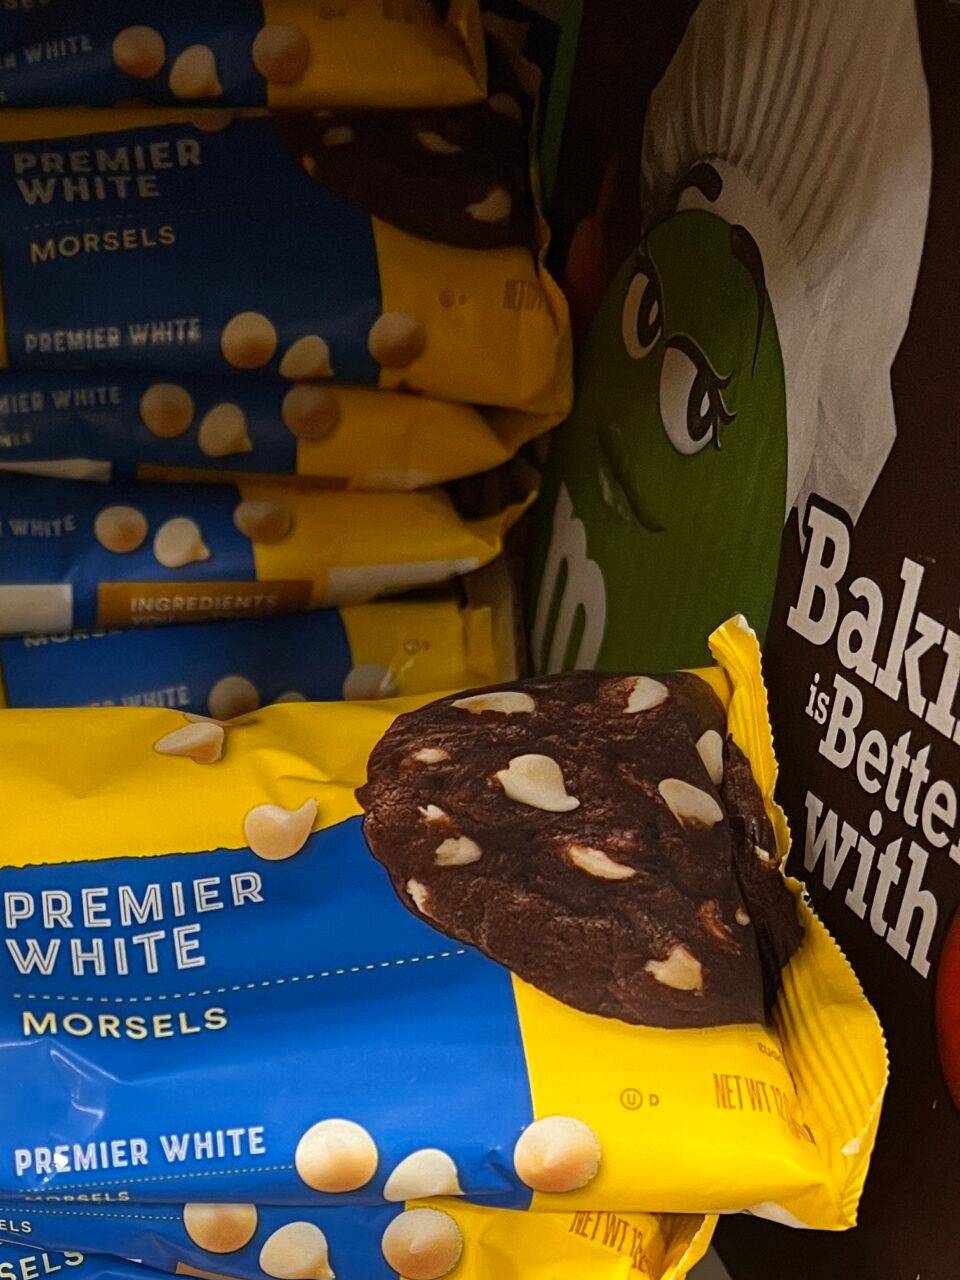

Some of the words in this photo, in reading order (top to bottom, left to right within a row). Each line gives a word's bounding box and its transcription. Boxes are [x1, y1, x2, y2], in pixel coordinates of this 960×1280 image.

[14, 138, 202, 175] PREMIER
[16, 174, 160, 206] WHITE
[31, 226, 176, 264] MORSELS
[24, 327, 120, 353] PREMIER
[127, 319, 201, 348] WHITE
[53, 386, 121, 409] WHITE
[10, 514, 76, 537] WHITE
[787, 505, 960, 746] Baki
[805, 672, 830, 725] is
[818, 672, 960, 861] Bette
[3, 872, 264, 930] PREMIER
[804, 790, 939, 978] with
[5, 923, 206, 977] WHITE
[23, 1007, 228, 1039] MORSELS
[713, 1073, 744, 1111] NET
[745, 1078, 771, 1112] WT
[15, 1139, 148, 1176] PREMIER
[160, 1126, 266, 1161] WHITE
